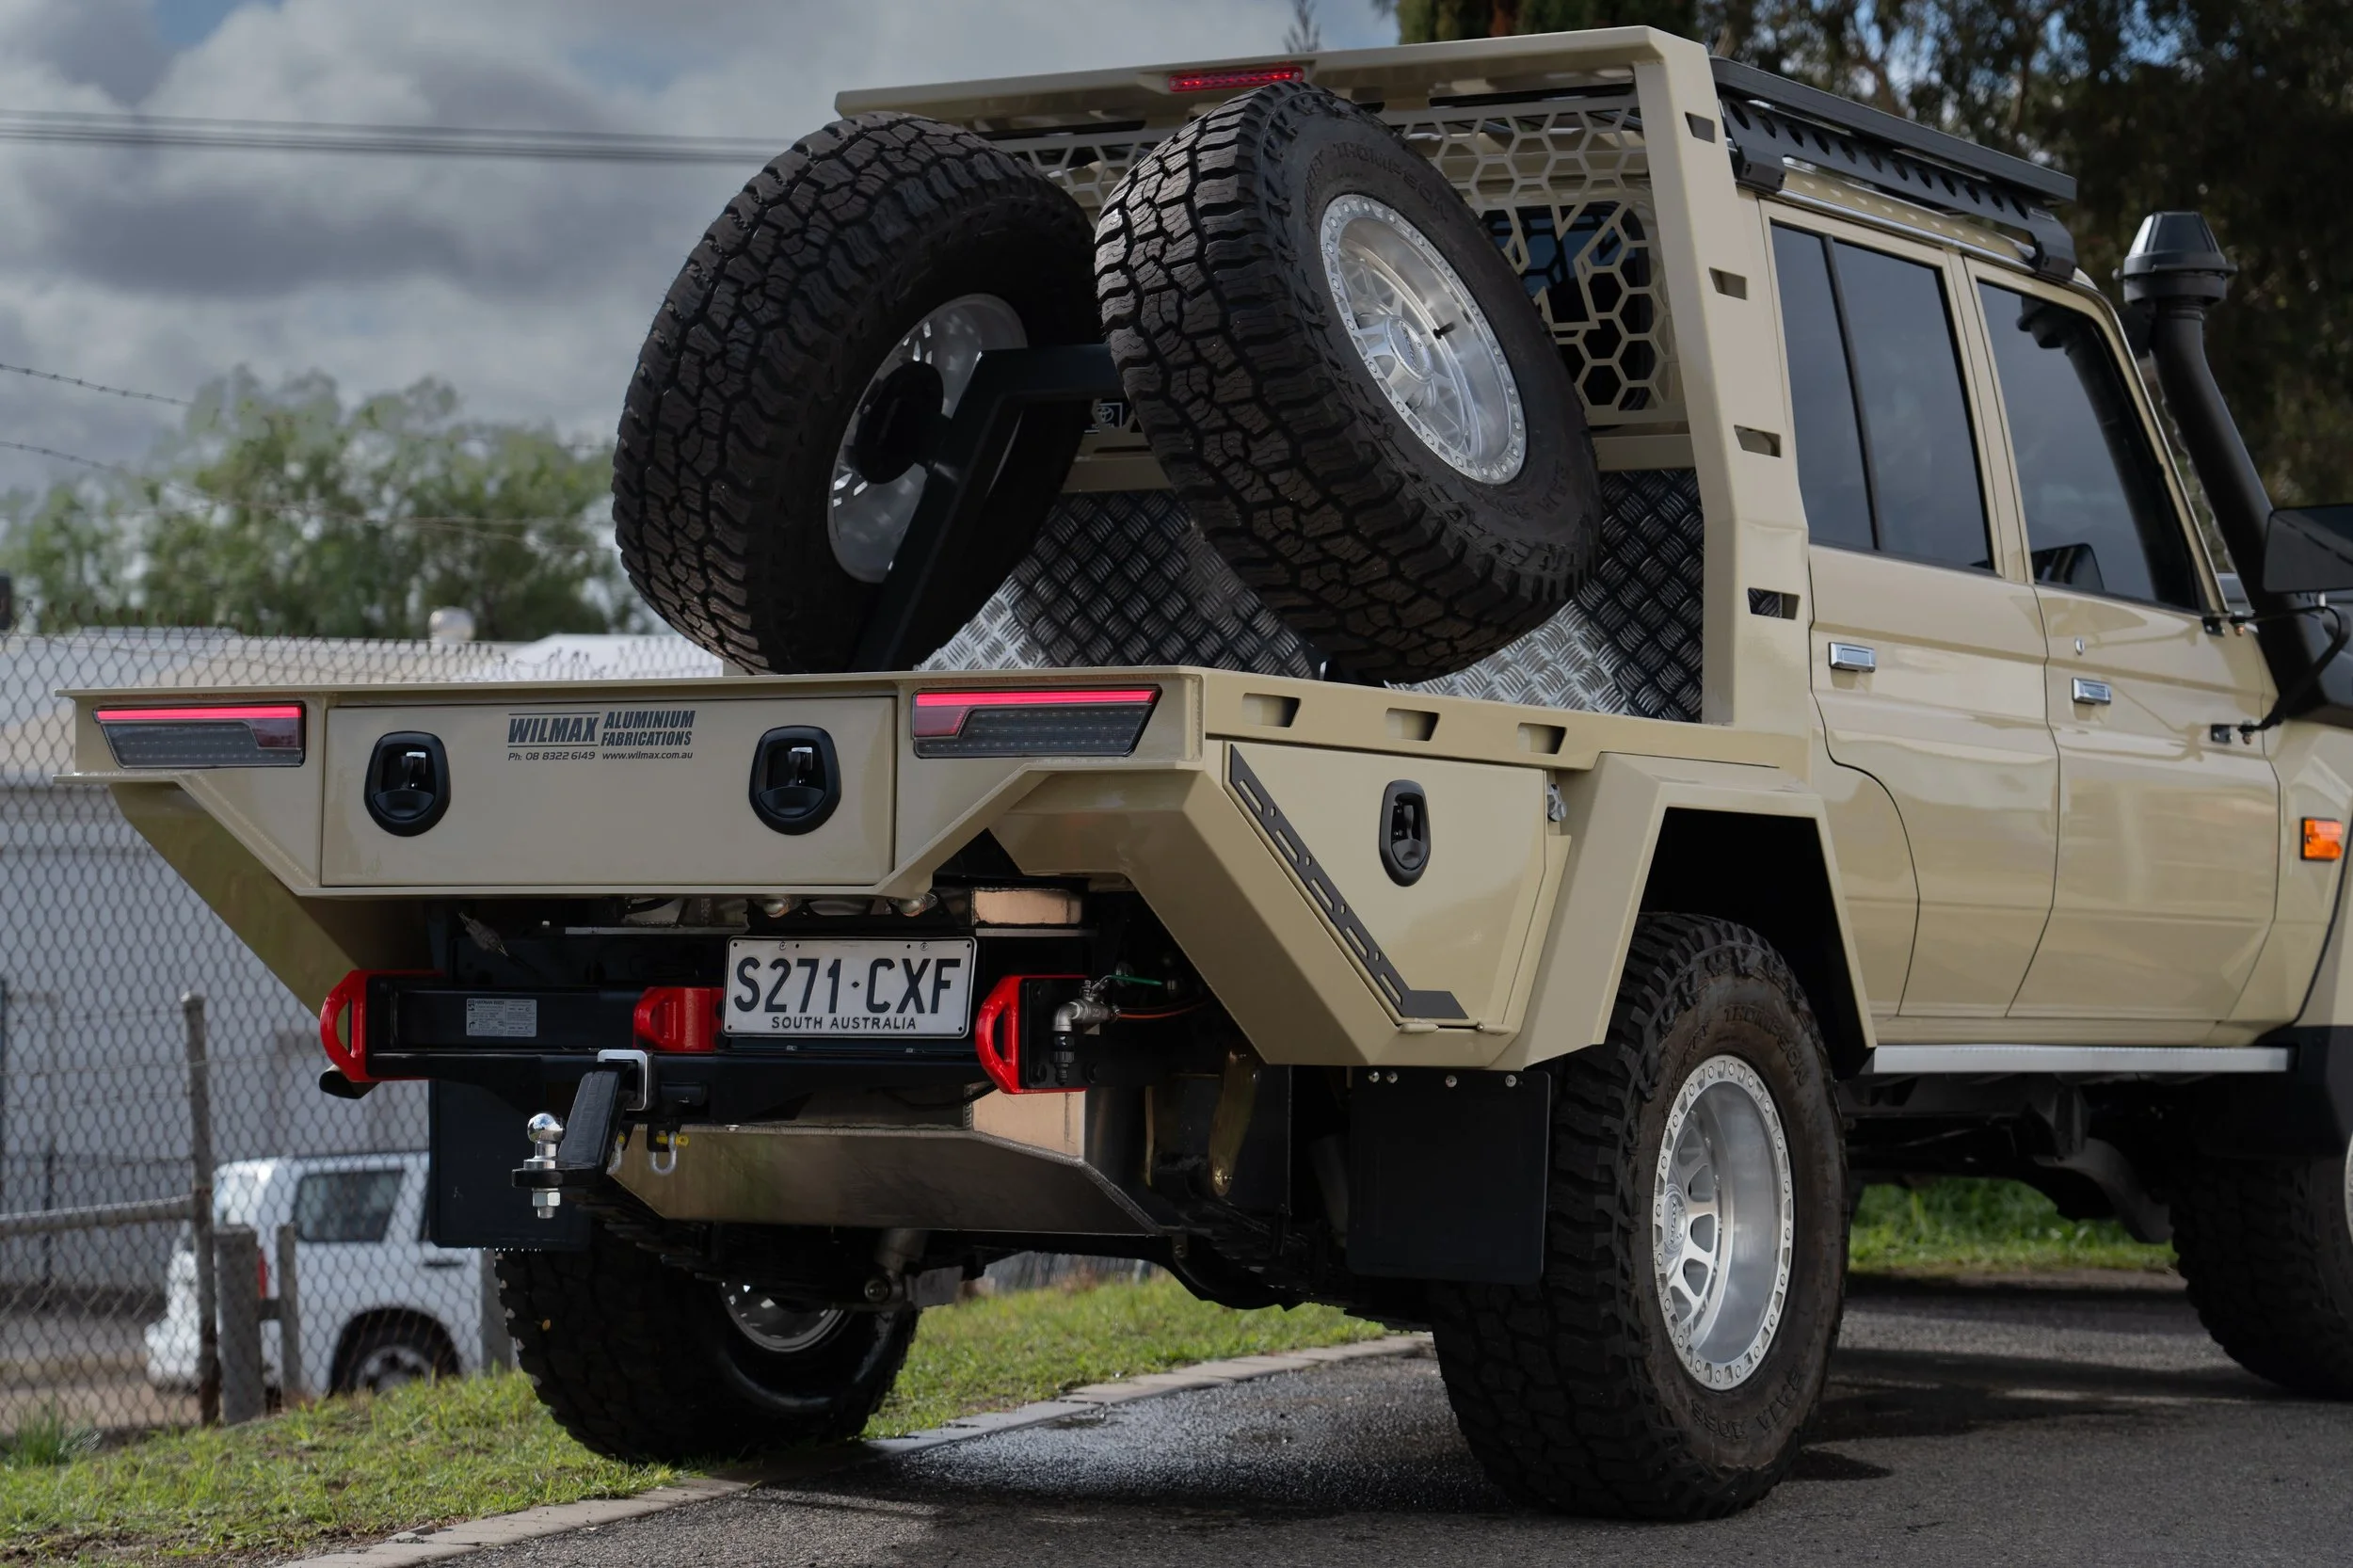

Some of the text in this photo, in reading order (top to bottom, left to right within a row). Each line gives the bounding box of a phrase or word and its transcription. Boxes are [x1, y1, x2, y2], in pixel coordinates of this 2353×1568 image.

[603, 710, 696, 729] ALUMINIUM
[507, 716, 600, 744] WILMAX
[600, 730, 692, 746] FABRICATIONS
[507, 751, 596, 761] Ph: 08 8322 6149
[601, 750, 694, 760] www.wilmax.com.au
[771, 1016, 917, 1031] SOUTH AUSTRALIA
